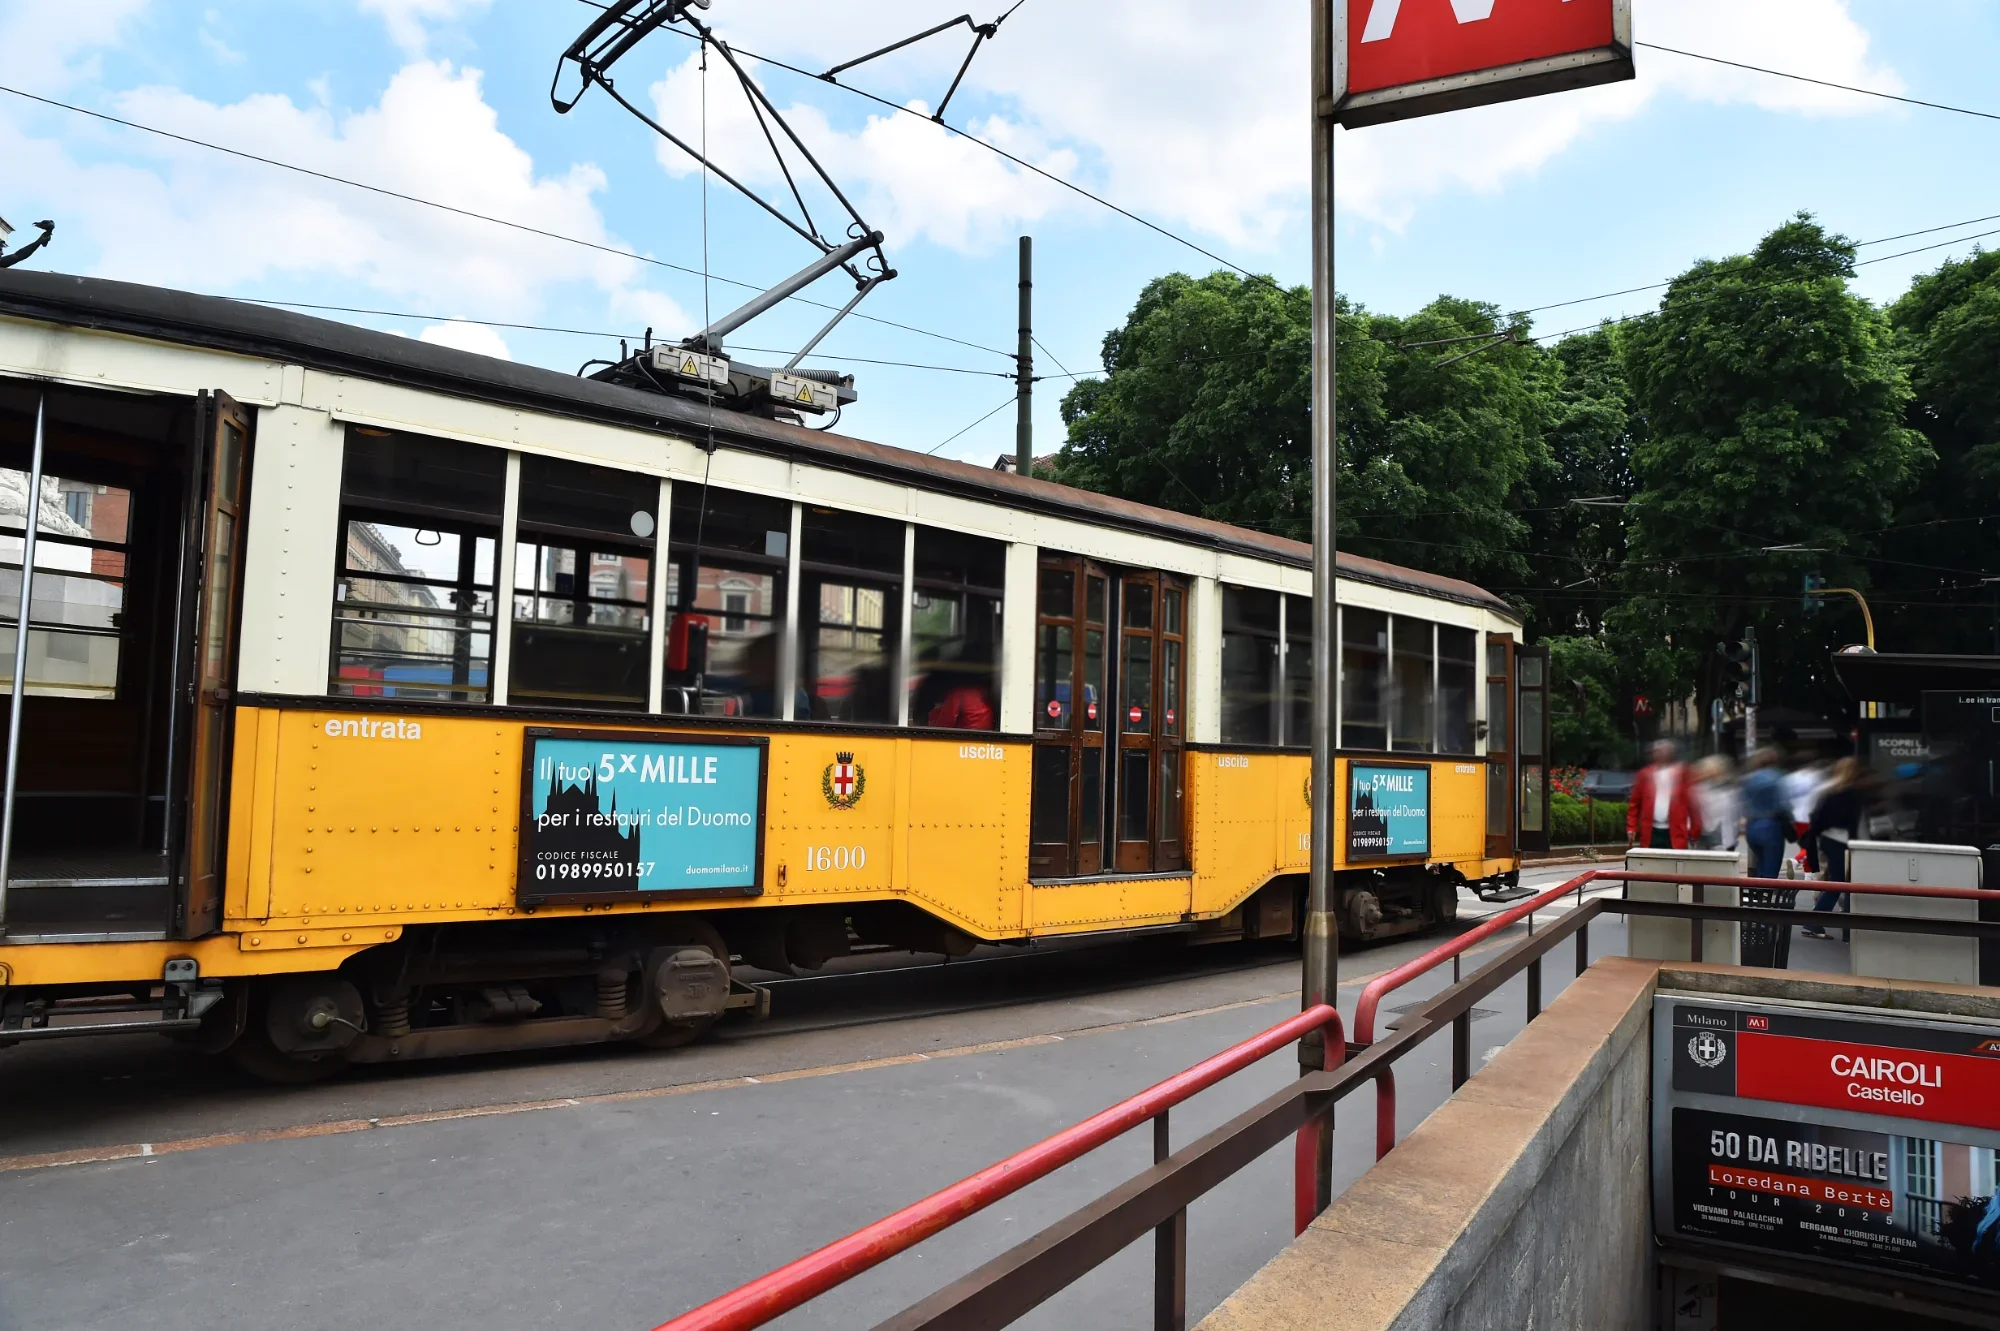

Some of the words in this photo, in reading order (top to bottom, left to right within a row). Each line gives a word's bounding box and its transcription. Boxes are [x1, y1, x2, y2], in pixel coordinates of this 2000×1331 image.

[324, 718, 421, 740] entrata
[1878, 738, 1914, 748] SCOPRI
[959, 744, 1004, 761] uscita
[539, 756, 552, 780] Il
[559, 761, 591, 781] tuo
[1218, 755, 1249, 769] uscita
[1455, 763, 1476, 774] entrata
[1359, 779, 1371, 791] tuo
[538, 811, 570, 833] per
[575, 808, 580, 826] i
[586, 808, 651, 827] restauri
[656, 806, 683, 826] del
[687, 806, 751, 827] Duomo
[1352, 808, 1364, 821] per
[1368, 805, 1391, 817] restauri
[1392, 804, 1402, 817] del
[1402, 804, 1426, 817] Duomo
[1298, 833, 1311, 851] 16
[1352, 837, 1394, 848] 01989950157
[537, 851, 576, 860] CODICE
[581, 850, 619, 860] FISCALE
[806, 845, 866, 871] 1600
[535, 861, 656, 880] 01989950157
[685, 863, 749, 875] duomomilano.it
[1687, 1014, 1727, 1027] Milano
[1748, 1018, 1765, 1028] M1
[1830, 1053, 1942, 1088] CAIROLI
[1847, 1082, 1925, 1106] Castello
[1710, 1129, 1741, 1159] 50
[1748, 1134, 1780, 1165] DA
[1786, 1140, 1888, 1181] RIBELLE
[1710, 1169, 1811, 1196] Loredana
[1825, 1186, 1891, 1208] Bertè
[1692, 1203, 1729, 1216] VIGEVANO
[1733, 1210, 1784, 1225] PALAELACHEM
[1800, 1221, 1838, 1234] BERGAMO
[1843, 1228, 1890, 1244] CHORUSLIFE
[1891, 1236, 1917, 1248] ARENA
